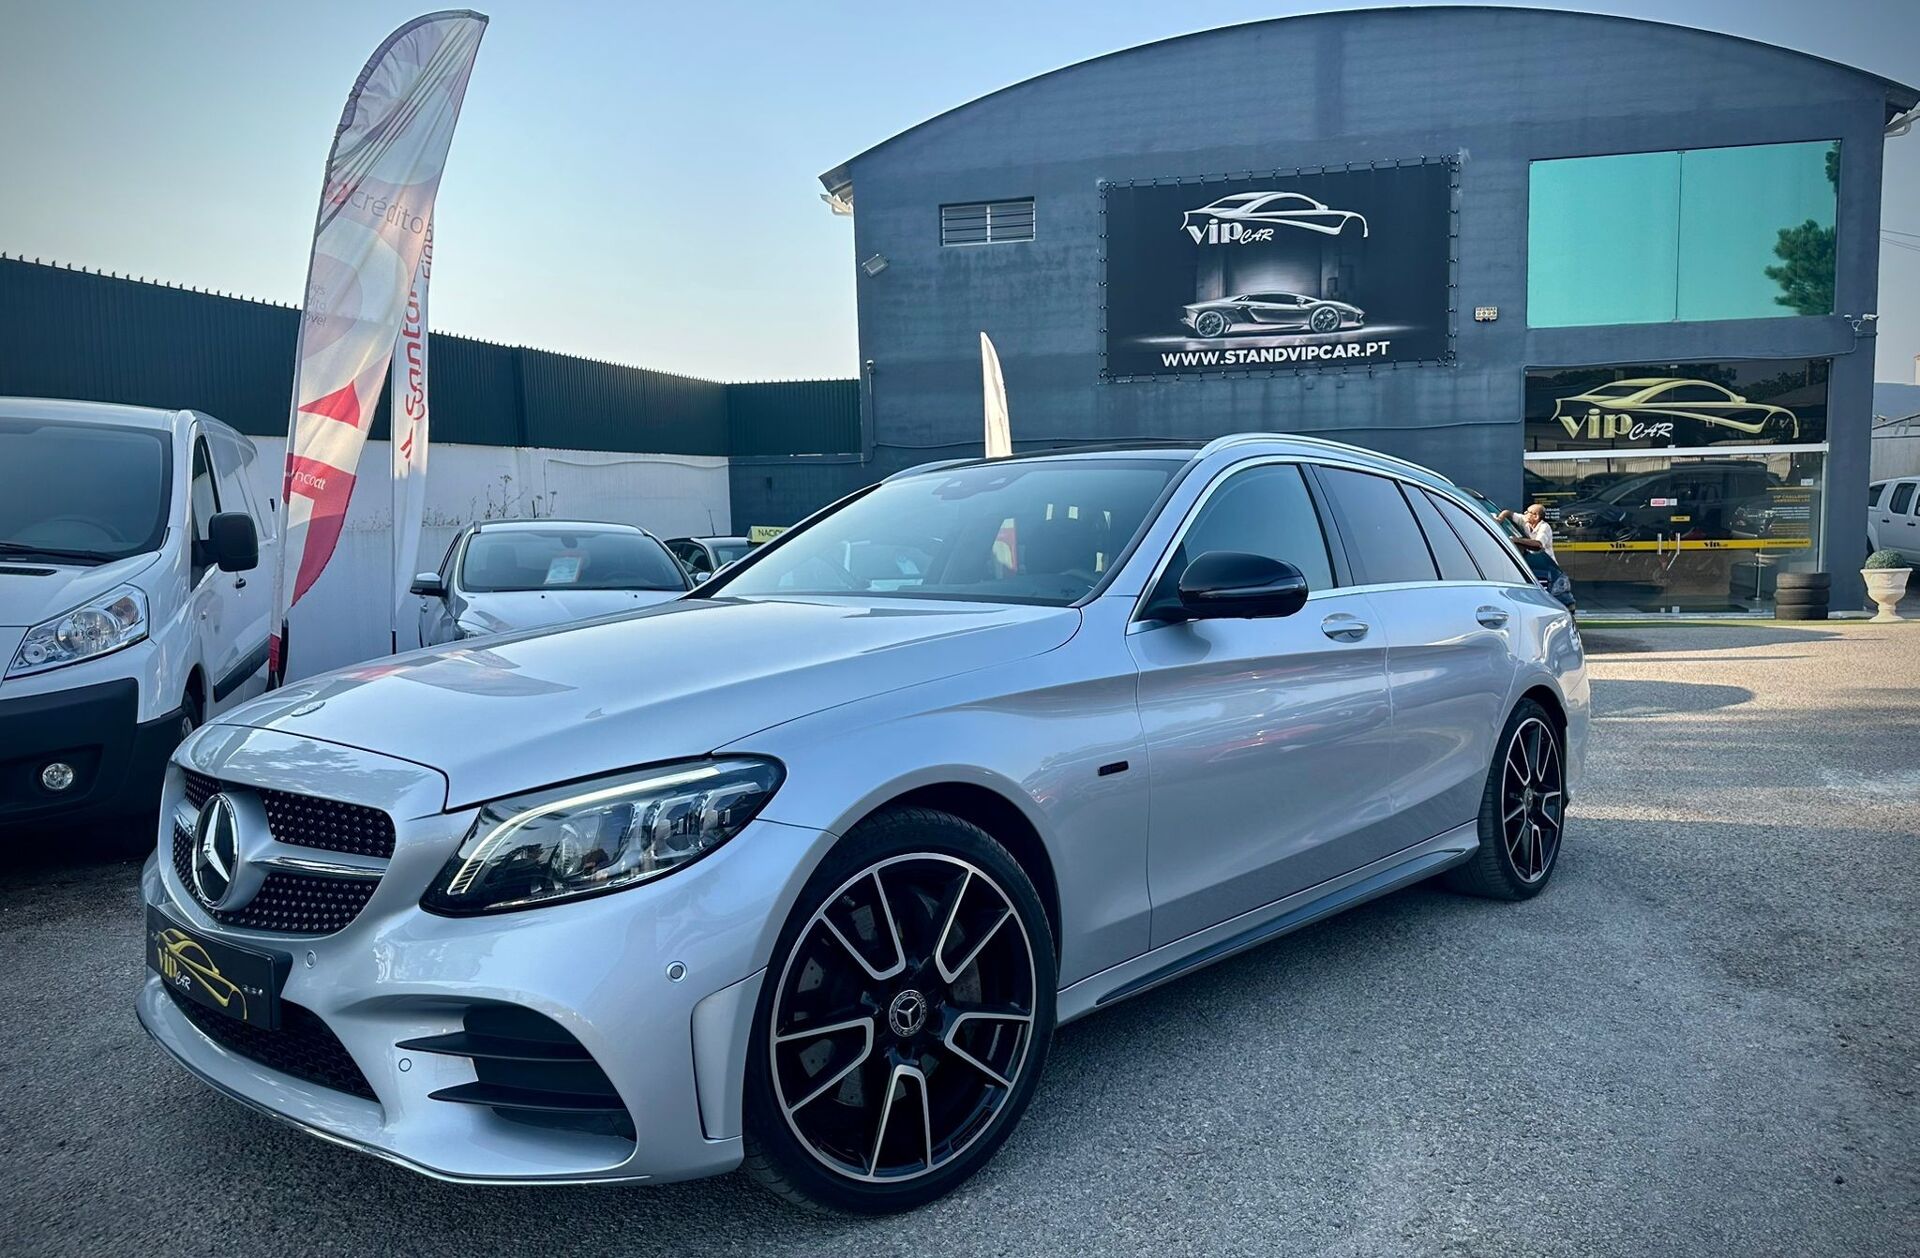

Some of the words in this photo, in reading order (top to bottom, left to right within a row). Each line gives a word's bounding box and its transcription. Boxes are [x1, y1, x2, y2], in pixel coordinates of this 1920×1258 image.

[350, 190, 424, 234] crédito
[1240, 229, 1274, 244] CAR
[1162, 341, 1390, 367] WWW.STANDVIPCAR.PT
[1629, 422, 1674, 440] CAR
